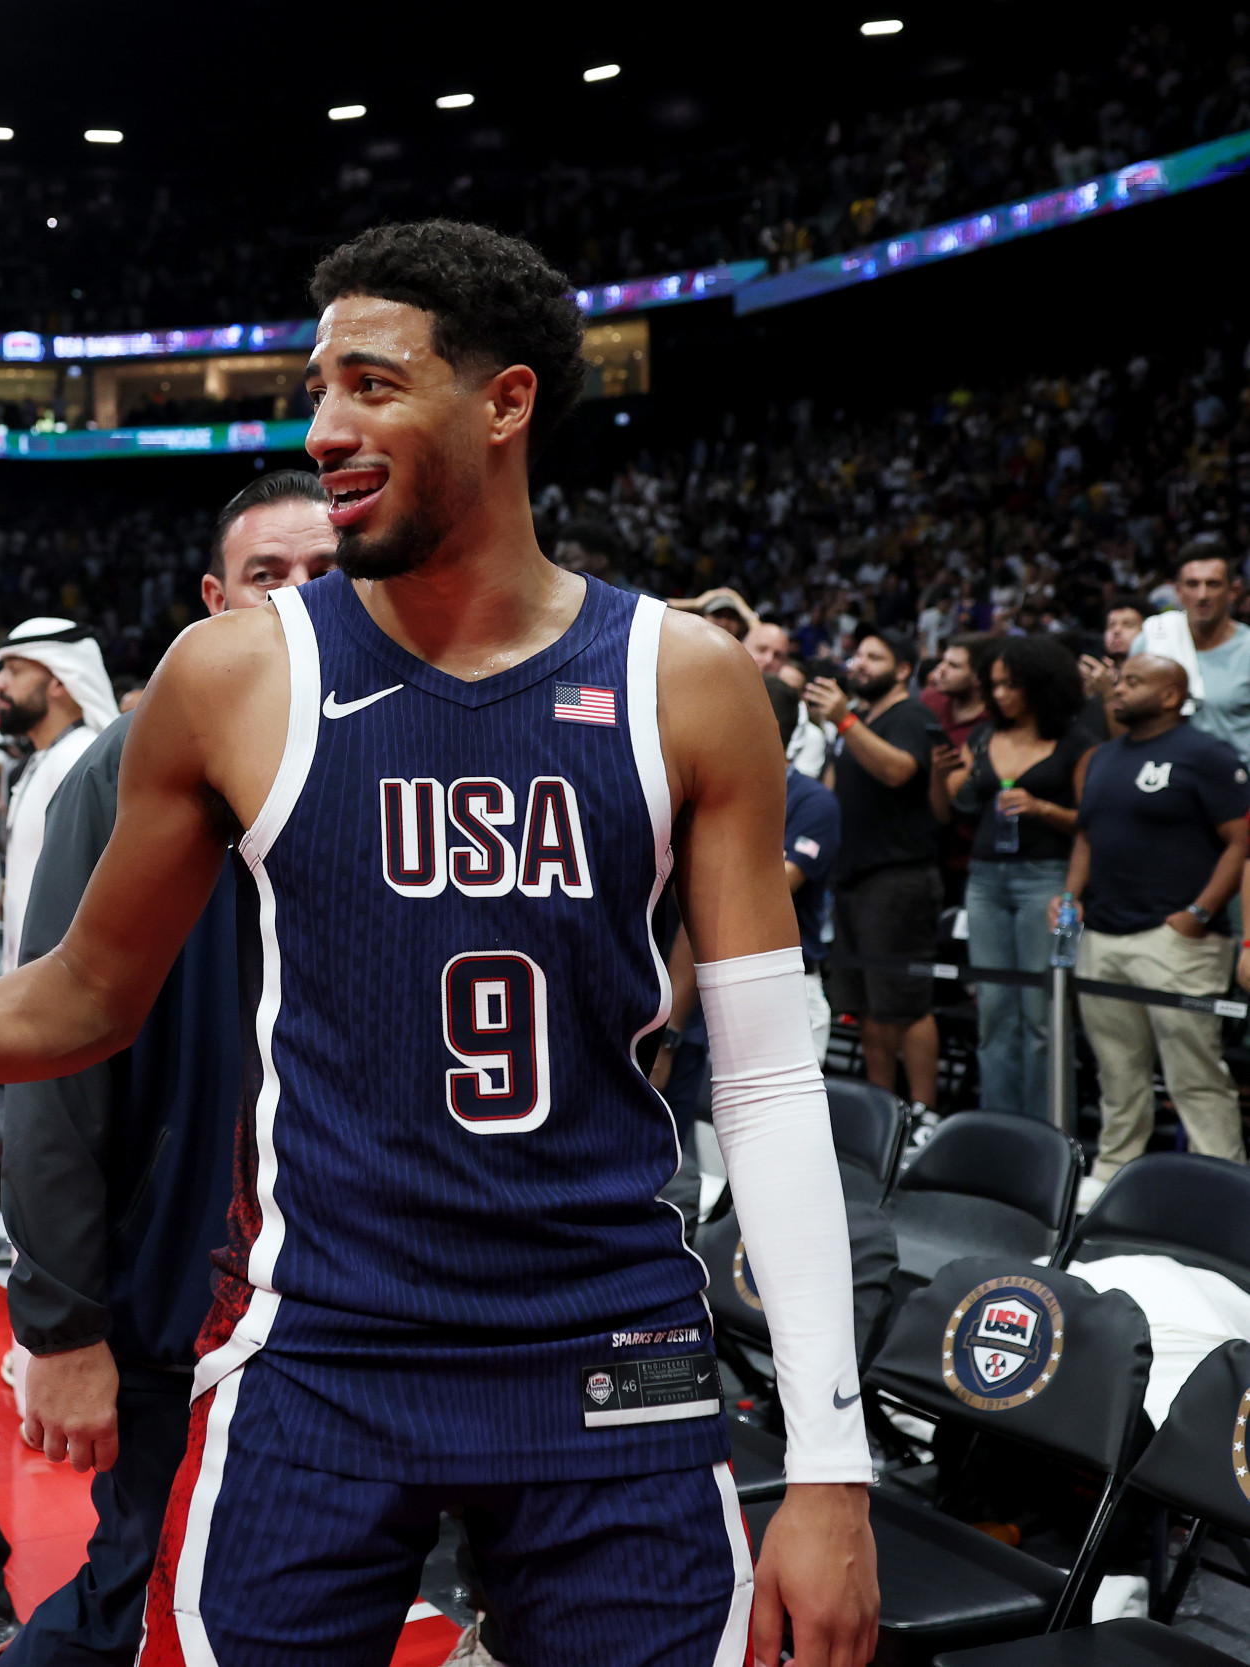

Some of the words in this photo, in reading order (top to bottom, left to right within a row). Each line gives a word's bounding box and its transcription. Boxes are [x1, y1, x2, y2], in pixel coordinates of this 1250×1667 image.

[379, 776, 594, 899] USA
[441, 950, 551, 1136] 9
[612, 1332, 653, 1348] SPARKS
[653, 1331, 667, 1344] OF
[984, 1308, 1030, 1340] USA
[622, 1379, 637, 1393] 46
